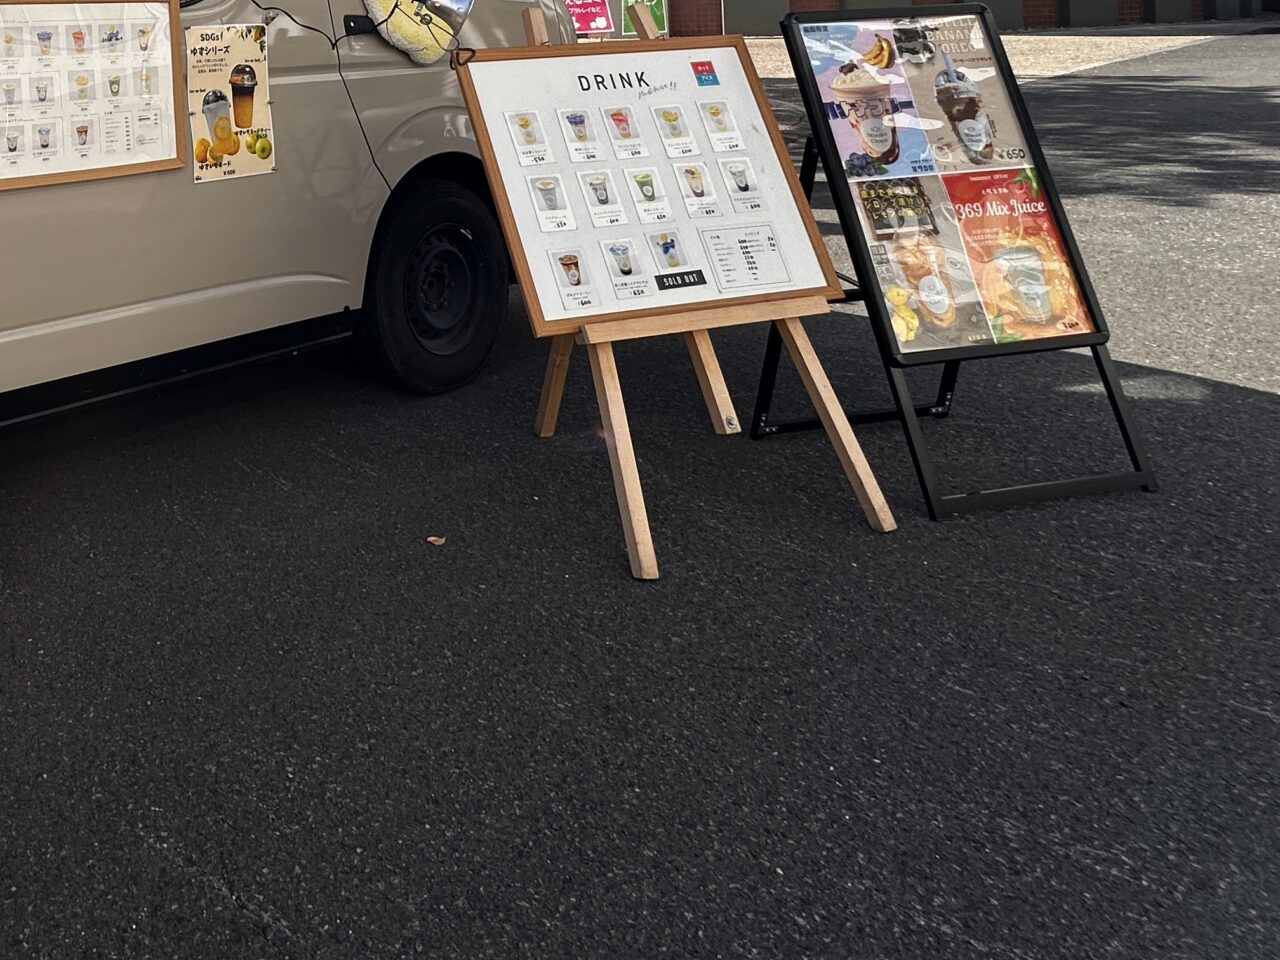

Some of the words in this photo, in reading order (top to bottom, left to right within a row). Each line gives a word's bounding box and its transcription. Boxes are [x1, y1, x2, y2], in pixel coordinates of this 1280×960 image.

[925, 28, 984, 41] BANAN
[191, 45, 230, 56] ゆずシリーズ
[578, 71, 650, 91] DRINK
[955, 203, 982, 219] 369
[984, 201, 1010, 217] Mix
[1010, 199, 1047, 217] Juice
[663, 276, 681, 287] SOLD
[684, 273, 699, 284] OUT
